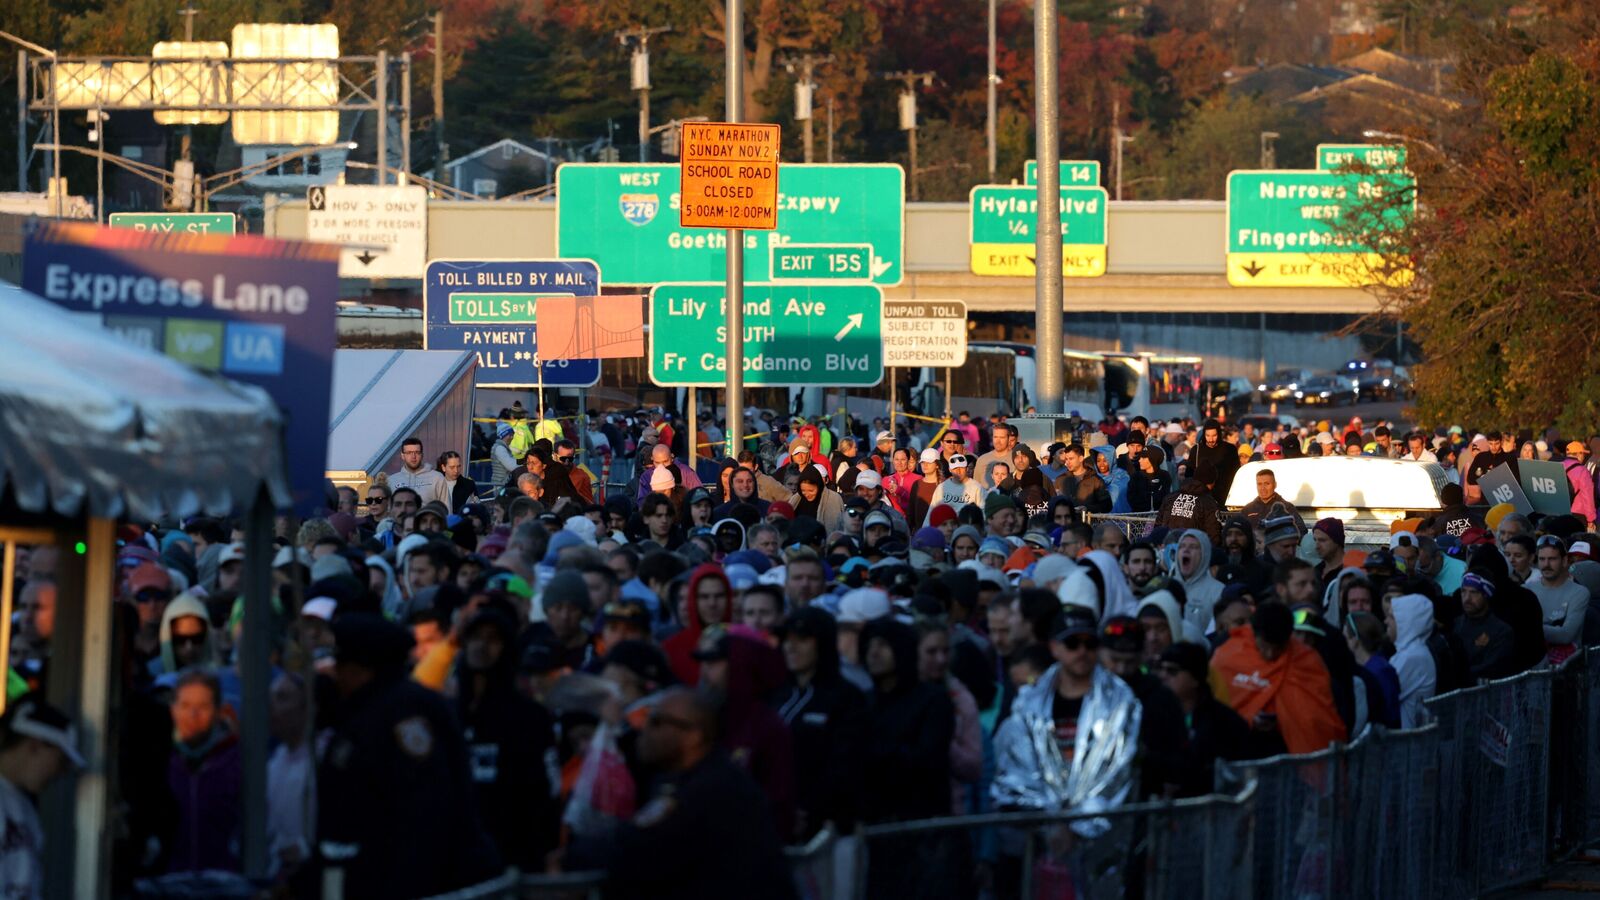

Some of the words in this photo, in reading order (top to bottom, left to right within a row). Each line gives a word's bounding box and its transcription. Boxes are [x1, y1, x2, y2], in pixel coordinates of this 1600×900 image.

[719, 129, 770, 142] MARATHON
[690, 144, 734, 157] SUNDAY
[1326, 152, 1353, 164] EXIT
[619, 172, 661, 187] WEST
[688, 165, 734, 178] SCHOOL
[739, 166, 772, 179] ROAD
[1071, 166, 1091, 182] 14
[704, 185, 754, 198] CLOSED
[1260, 181, 1347, 199] Narrows
[385, 202, 418, 212] ONLY
[625, 203, 655, 218] 278
[777, 193, 841, 214] Expwy
[1301, 204, 1341, 219] WEST
[781, 255, 815, 270] EXIT
[828, 254, 862, 272] 15S
[989, 255, 1020, 266] EXIT
[1064, 256, 1096, 268] NLY
[1280, 264, 1311, 275] EXIT
[438, 272, 472, 285] TOLL
[477, 272, 523, 286] BILLED
[529, 272, 548, 286] BY
[555, 272, 586, 286] MAIL
[45, 264, 204, 309] Express
[212, 274, 309, 315] Lane
[455, 300, 511, 317] TOLLS
[668, 298, 707, 320] Lily
[784, 298, 826, 316] Ave
[884, 306, 925, 317] UNPAID
[932, 306, 958, 317] TOLL
[888, 321, 934, 331] SUBJECT
[943, 321, 955, 331] TO
[463, 332, 526, 344] PAYMENT
[716, 326, 775, 342] SUTH
[884, 336, 958, 346] REGISTRATION
[175, 332, 214, 353] VIP
[231, 334, 275, 362] UA
[476, 351, 510, 368] ALL
[664, 353, 687, 371] Fr
[700, 353, 812, 371] Caodanno
[825, 353, 868, 371] Blvd
[888, 351, 954, 361] SUSPENSION
[1531, 476, 1557, 494] NB
[1176, 493, 1198, 503] APEX
[1492, 483, 1514, 503] NB
[1446, 518, 1471, 530] APEX
